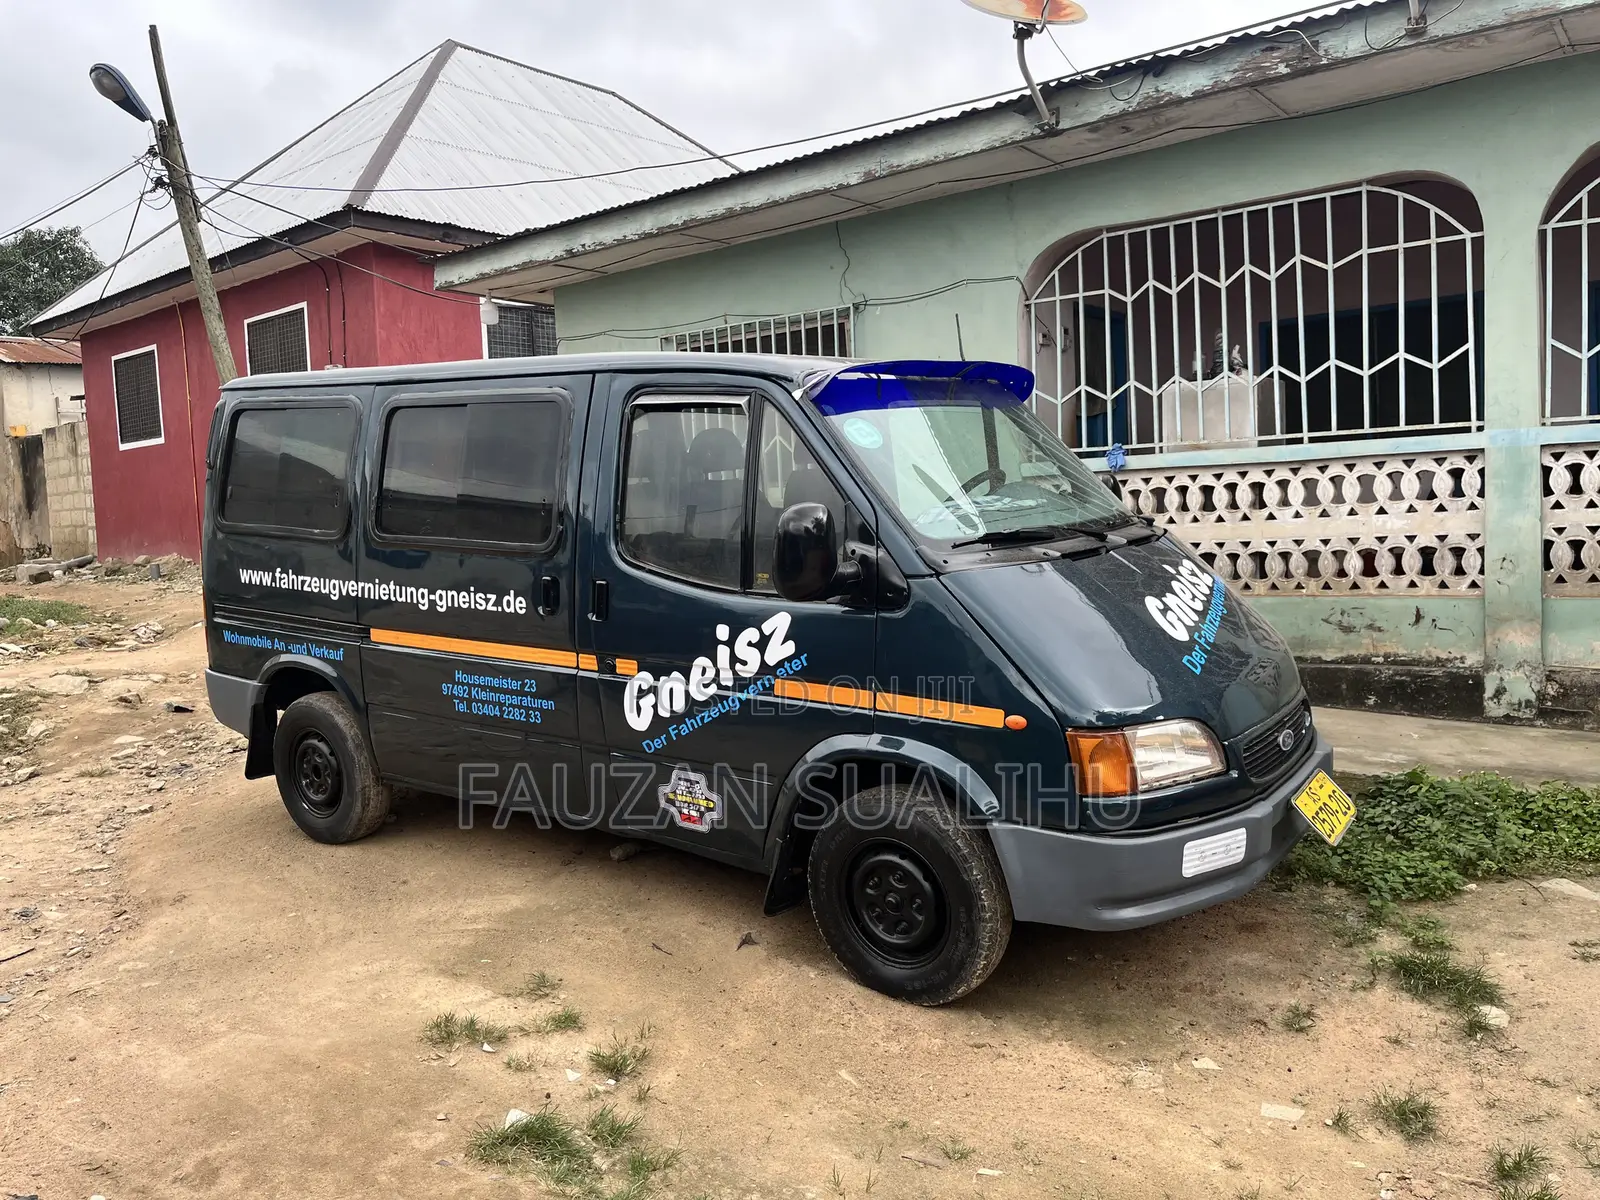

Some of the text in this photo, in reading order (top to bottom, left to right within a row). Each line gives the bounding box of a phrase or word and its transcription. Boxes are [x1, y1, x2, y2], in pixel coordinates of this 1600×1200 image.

[239, 567, 527, 616] www.fahrzeugvernietung-gneisz.de
[1144, 558, 1214, 642] Gneisz
[223, 629, 273, 650] Wohnmobile
[273, 639, 286, 651] An
[309, 644, 344, 661] Verkauf
[1181, 644, 1208, 676] Der
[455, 669, 537, 692] Housemeister 23
[622, 611, 796, 732] Gneisz
[441, 682, 556, 711] 97492 Kleinreparaturen
[453, 699, 542, 724] Tel. 03404 2282 33
[641, 733, 668, 754] Der
[1306, 786, 1321, 806] AS
